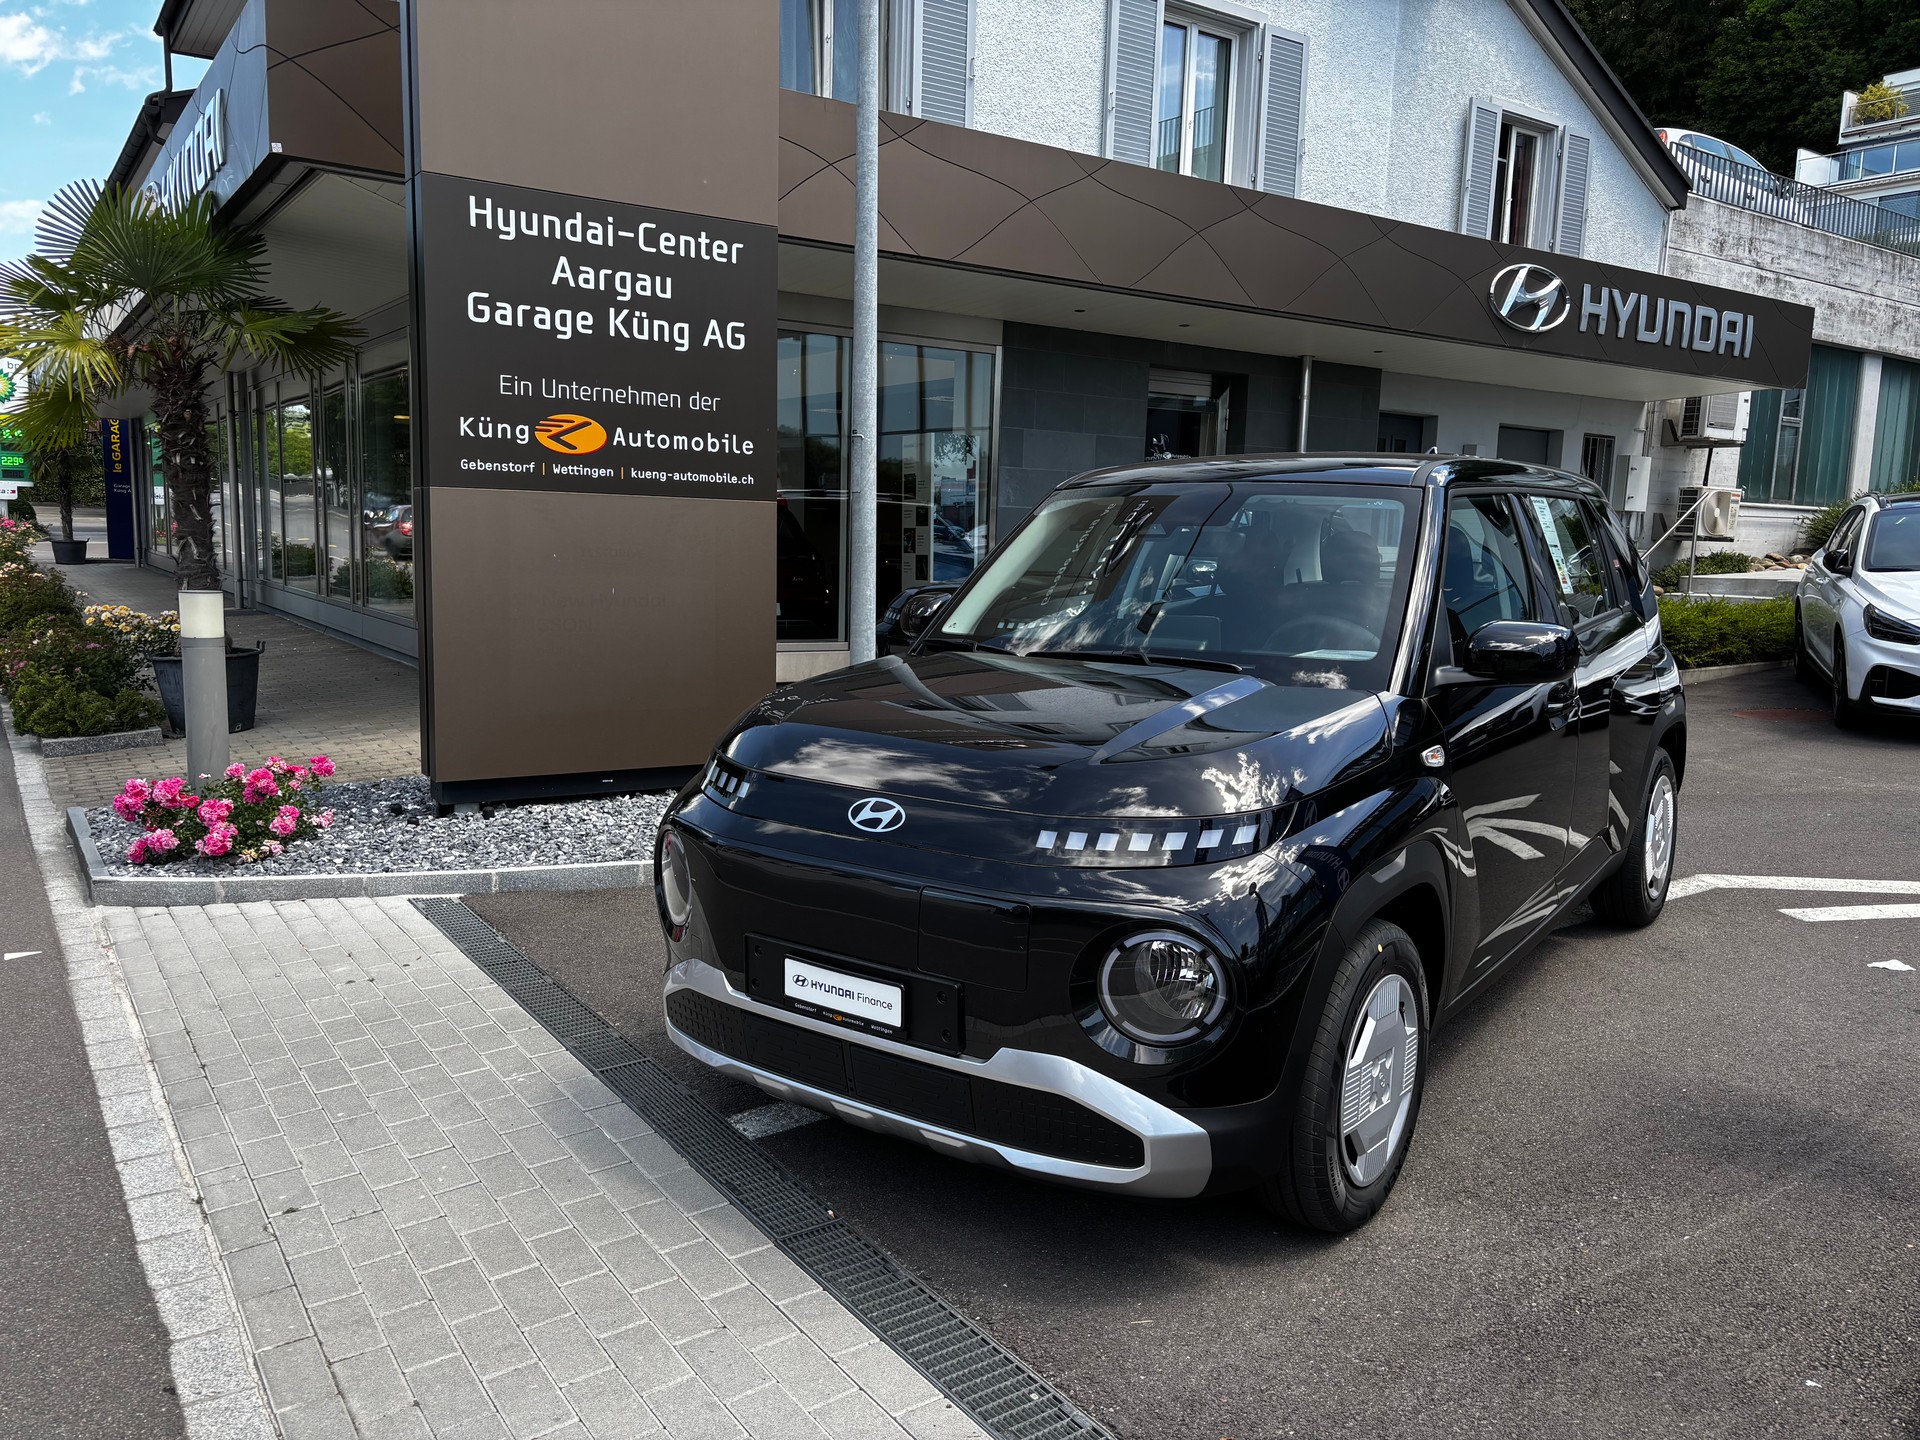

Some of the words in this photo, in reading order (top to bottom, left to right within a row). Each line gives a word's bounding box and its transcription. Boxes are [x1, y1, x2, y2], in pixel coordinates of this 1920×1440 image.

[468, 194, 744, 265] Hyundai-Center
[551, 255, 672, 302] Aargau
[467, 291, 594, 340] Garage
[609, 307, 690, 352] Küng
[702, 318, 746, 351] AG
[1579, 283, 1755, 359] HYUNDAI
[499, 374, 533, 397] Ein
[542, 377, 681, 409] Unternehmen
[689, 391, 721, 412] der
[109, 418, 122, 461] GARAG
[459, 416, 529, 445] Küng
[612, 426, 754, 455] Automobile
[112, 463, 122, 473] le
[460, 458, 536, 474] Gebenstorf
[552, 463, 614, 479] Wettingen
[631, 467, 754, 485] kueng-automobile.ch
[810, 979, 855, 1001] HYUNDAI
[856, 992, 893, 1011] Finance
